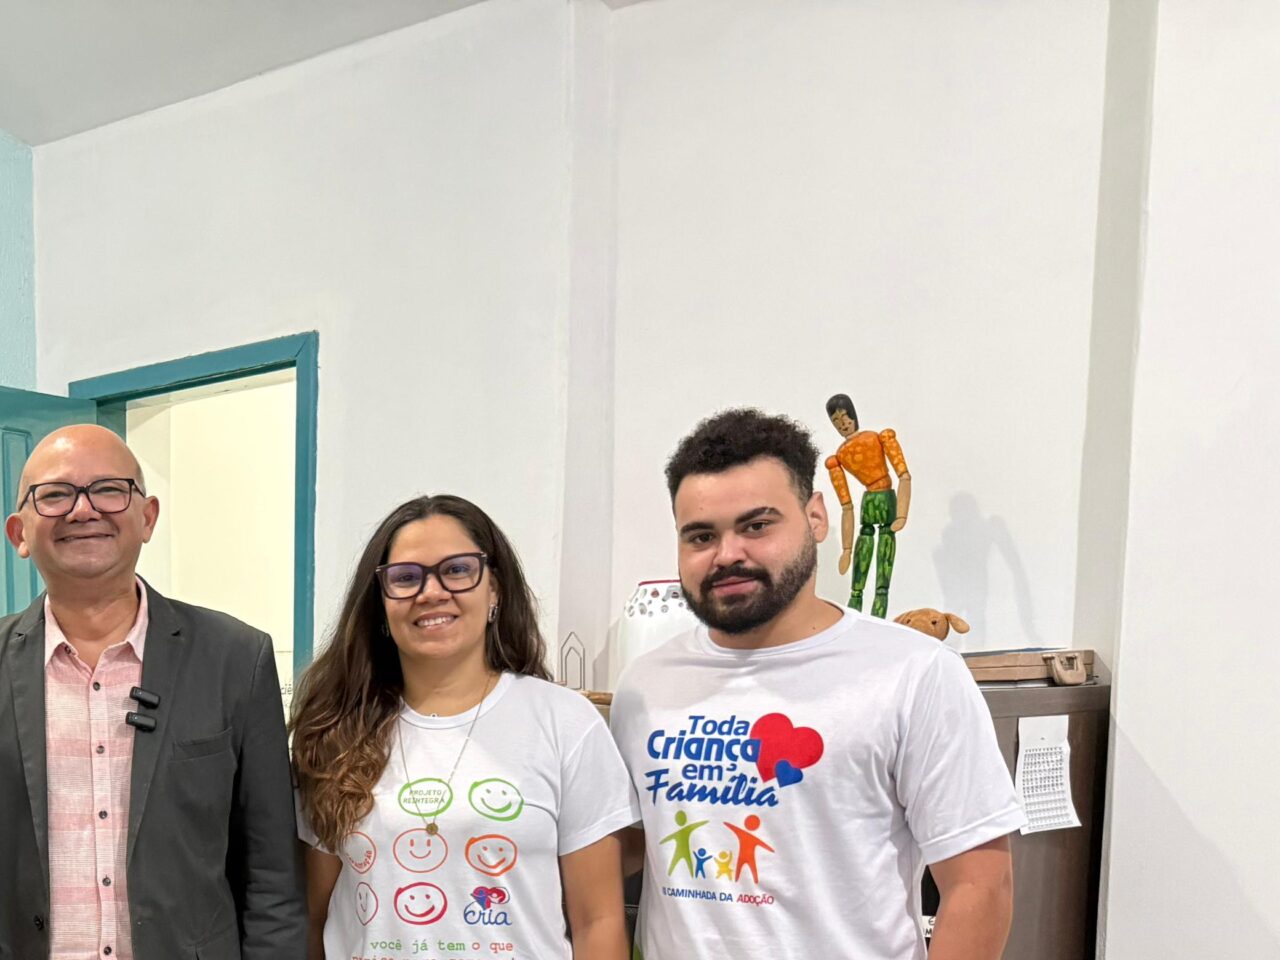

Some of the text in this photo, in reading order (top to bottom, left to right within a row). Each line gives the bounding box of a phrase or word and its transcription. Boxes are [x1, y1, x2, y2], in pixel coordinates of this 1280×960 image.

[687, 715, 750, 736] Toda
[647, 729, 761, 771] Criança
[681, 763, 723, 781] em
[644, 768, 779, 807] Família
[667, 887, 717, 900] CAMINHADA
[719, 892, 733, 903] DA
[736, 893, 775, 907] ADOÇÃO
[370, 939, 513, 954] você já tem o que
